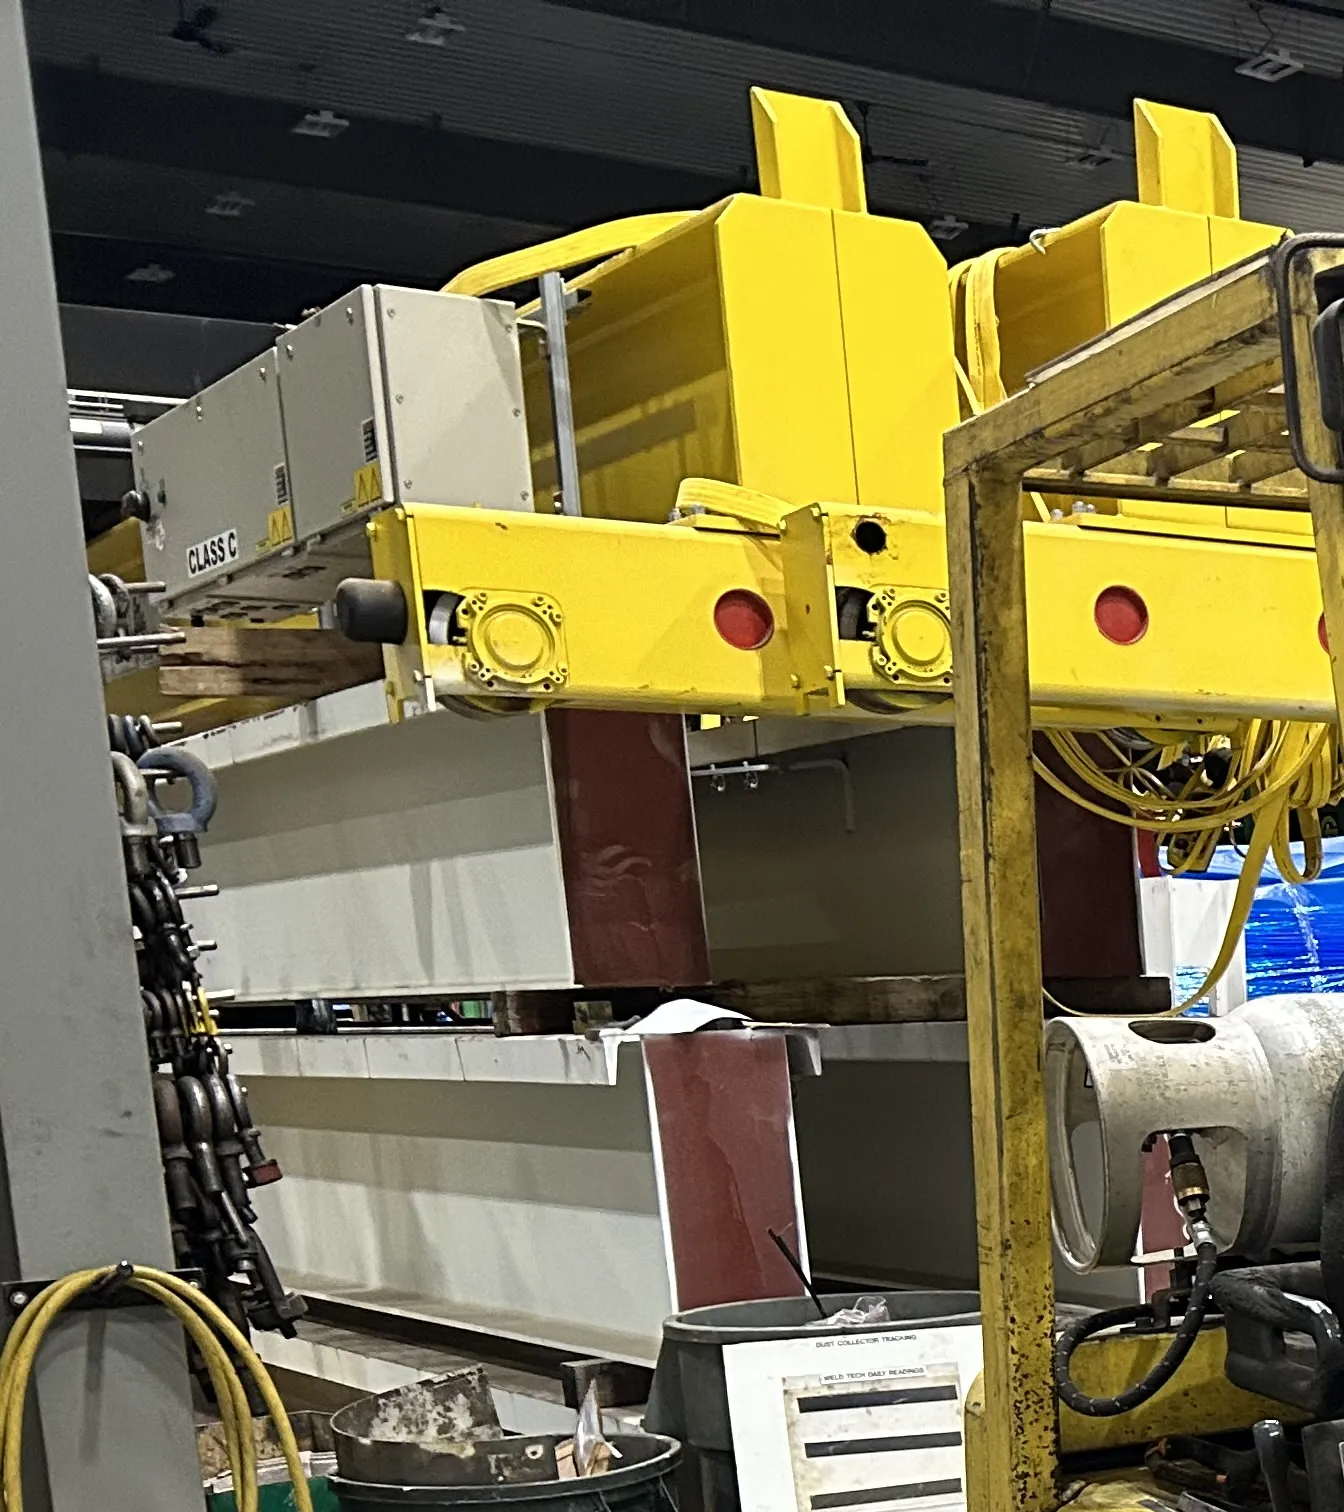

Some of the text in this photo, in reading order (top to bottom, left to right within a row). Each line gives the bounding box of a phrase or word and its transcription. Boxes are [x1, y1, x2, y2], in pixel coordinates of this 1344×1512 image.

[188, 531, 237, 575] CLASS C
[815, 1341, 835, 1349] DUST
[837, 1337, 880, 1347] COLLECTOR
[867, 1370, 886, 1378] DAILY
[888, 1367, 925, 1376] READINGS
